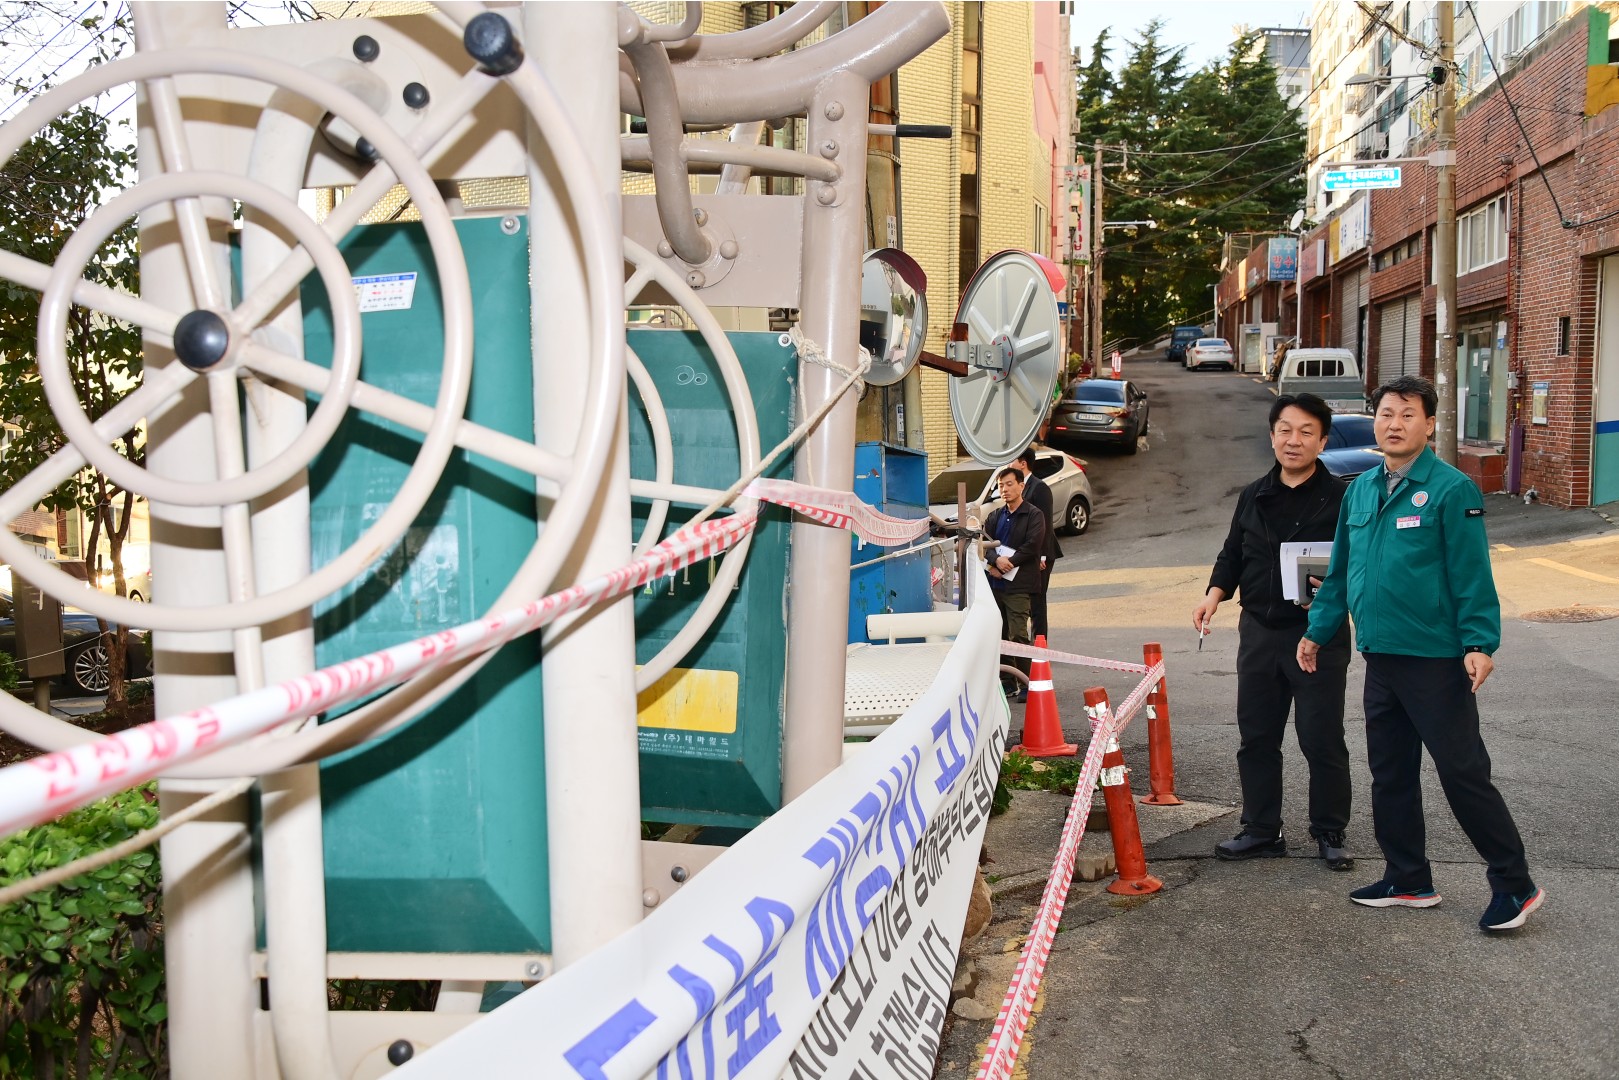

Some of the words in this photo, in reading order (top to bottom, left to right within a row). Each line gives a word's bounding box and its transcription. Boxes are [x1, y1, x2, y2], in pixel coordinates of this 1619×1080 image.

[1271, 241, 1294, 254] 누수
[1272, 255, 1295, 268] 방수
[663, 733, 681, 743] (주)
[912, 725, 1007, 907] 양해부탁드립니다
